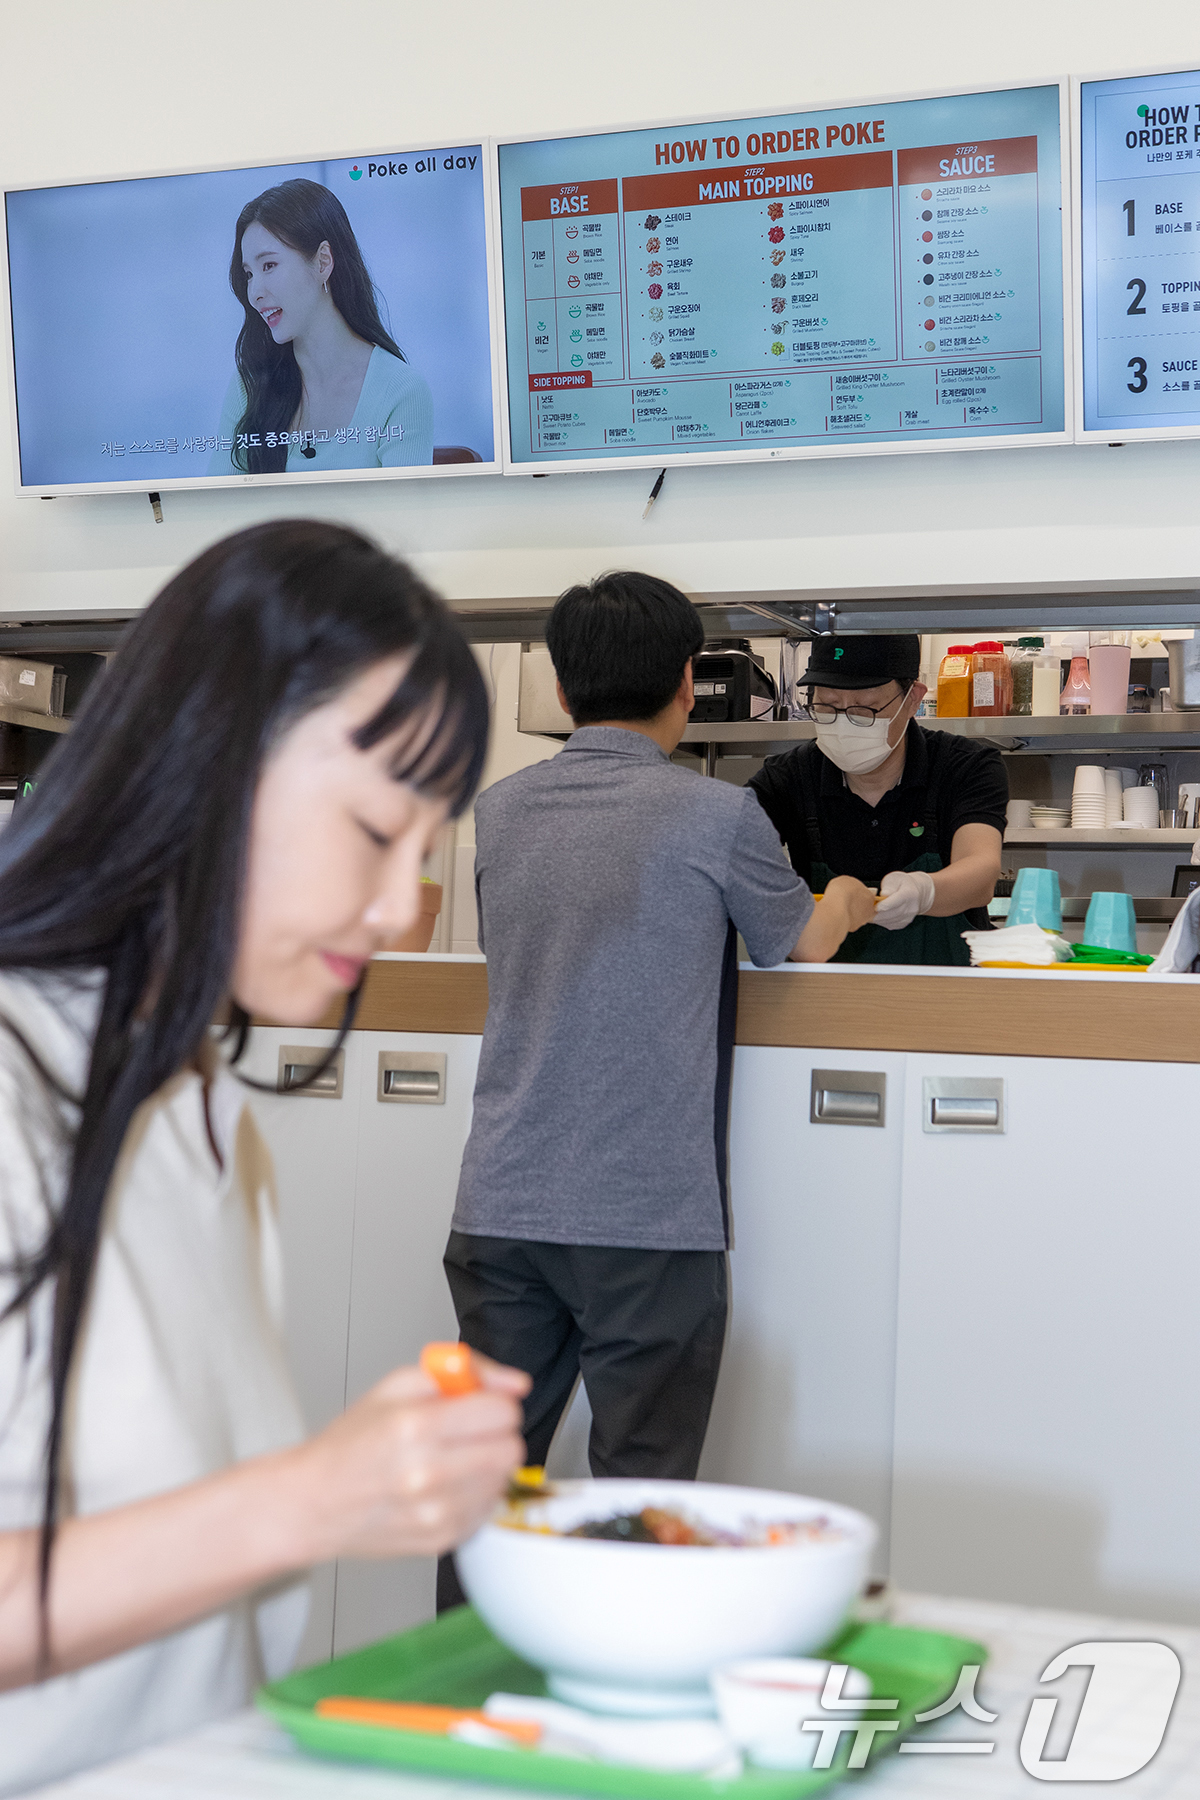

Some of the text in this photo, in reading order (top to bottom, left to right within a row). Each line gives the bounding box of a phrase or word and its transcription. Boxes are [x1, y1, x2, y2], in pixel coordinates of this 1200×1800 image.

[1145, 105, 1189, 127] HOW
[656, 120, 885, 165] HOW TO ORDER POKE
[1126, 126, 1188, 149] ORDER
[955, 146, 977, 155] STEP3
[1148, 152, 1172, 162] 나만의
[1176, 150, 1192, 160] 포케
[368, 156, 477, 177] Poke all day
[939, 155, 995, 177] SAUCE
[744, 168, 765, 177] STEP2
[560, 186, 579, 195] STEP1
[699, 173, 813, 200] MAIN TOPPING
[936, 184, 990, 196] 스리라차 마요 소스
[550, 195, 589, 214] BASE
[789, 199, 829, 210] 스파이시연어
[1156, 202, 1182, 214] BASE
[665, 212, 691, 222] 스테이크
[937, 207, 978, 218] 참깨 간장 소스
[1123, 200, 1135, 236] 1
[790, 222, 831, 234] 스파이시참치
[1156, 222, 1191, 233] 베이스를
[937, 231, 950, 239] 쌈장
[665, 236, 678, 245] 연어
[532, 251, 545, 260] 기본
[790, 247, 804, 256] 새우
[938, 249, 979, 260] 유자 간장 소스
[667, 258, 693, 268] 구운새우
[584, 272, 603, 280] 야채만
[791, 270, 818, 280] 소불고기
[938, 270, 992, 281] 고추냉이 간장 소스
[667, 282, 680, 290] 육회
[791, 293, 818, 303] 훈제오리
[939, 295, 951, 303] 비건
[953, 291, 991, 302] 크리미어니언
[1127, 278, 1146, 315] 2
[668, 304, 700, 314] 구운오징어
[1162, 302, 1189, 313] 토핑을
[792, 318, 819, 328] 구운버섯
[939, 316, 951, 324] 비건
[953, 315, 979, 323] 스리라차
[669, 327, 695, 337] 닭가슴살
[535, 335, 549, 344] 비건
[940, 338, 952, 346] 비건
[793, 342, 820, 351] 더블토핑
[941, 366, 987, 376] 느타리버섯구이
[1163, 360, 1197, 372] SAUCE
[835, 374, 880, 384] 새송이버섯구이
[1127, 357, 1147, 393] 3
[534, 375, 585, 387] SIDE TOPPING
[1163, 381, 1189, 391] 소스를
[735, 382, 772, 391] 아스파라거스
[637, 388, 660, 397] 아보카도
[836, 395, 855, 404] 연두부
[543, 413, 572, 422] 고구마큐브
[677, 424, 701, 432] 야채추가
[746, 418, 789, 428] 어니언후레이크
[101, 425, 405, 457] 저는 스스로를 사랑하는 것도 중요하다고 생각 합니다
[834, 648, 844, 660] P
